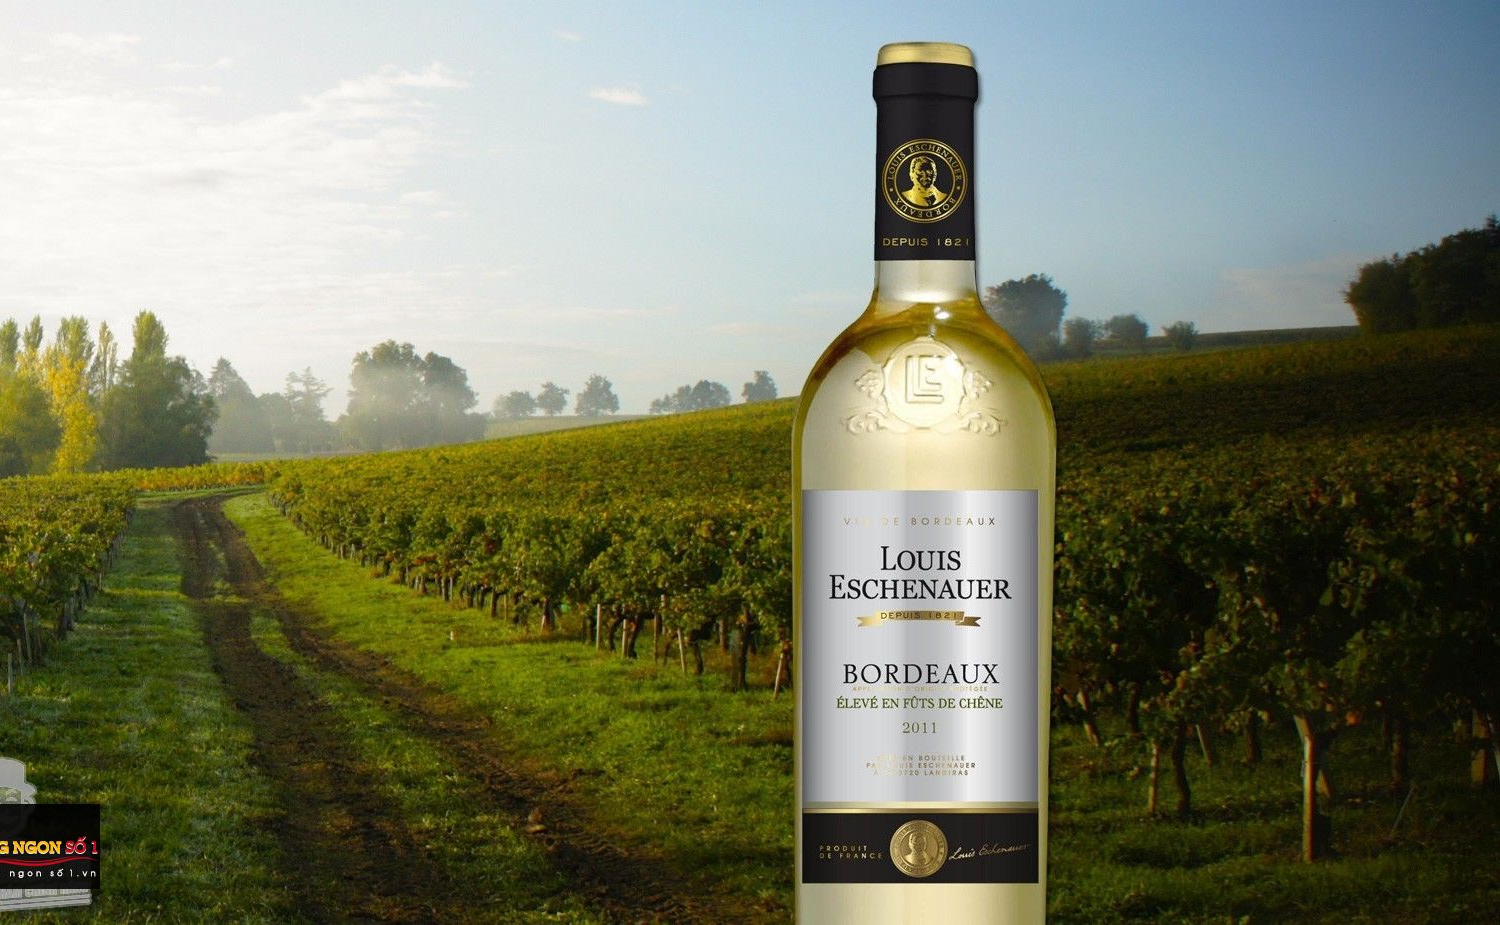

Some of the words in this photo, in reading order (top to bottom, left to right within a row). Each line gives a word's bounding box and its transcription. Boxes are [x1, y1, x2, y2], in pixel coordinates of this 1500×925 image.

[887, 151, 906, 181] LOUIS
[908, 143, 962, 181] ESCHENAUER
[894, 197, 956, 218] BORDEAUX
[882, 237, 928, 247] DEPUIS
[937, 237, 969, 247] 1821
[910, 517, 996, 526] BORDEAUX
[880, 545, 962, 571] LOUIS
[829, 574, 1012, 600] ESCHENAUER
[880, 612, 921, 620] DEPUIS
[928, 612, 958, 620] 1821
[843, 663, 1000, 684] BORDEAUX
[836, 696, 879, 709] ÉLEVÉ
[882, 698, 900, 709] EN
[903, 695, 935, 709] FÛTS
[938, 698, 956, 709] DE
[959, 695, 1003, 709] CHÊNE
[902, 721, 937, 734] 2011
